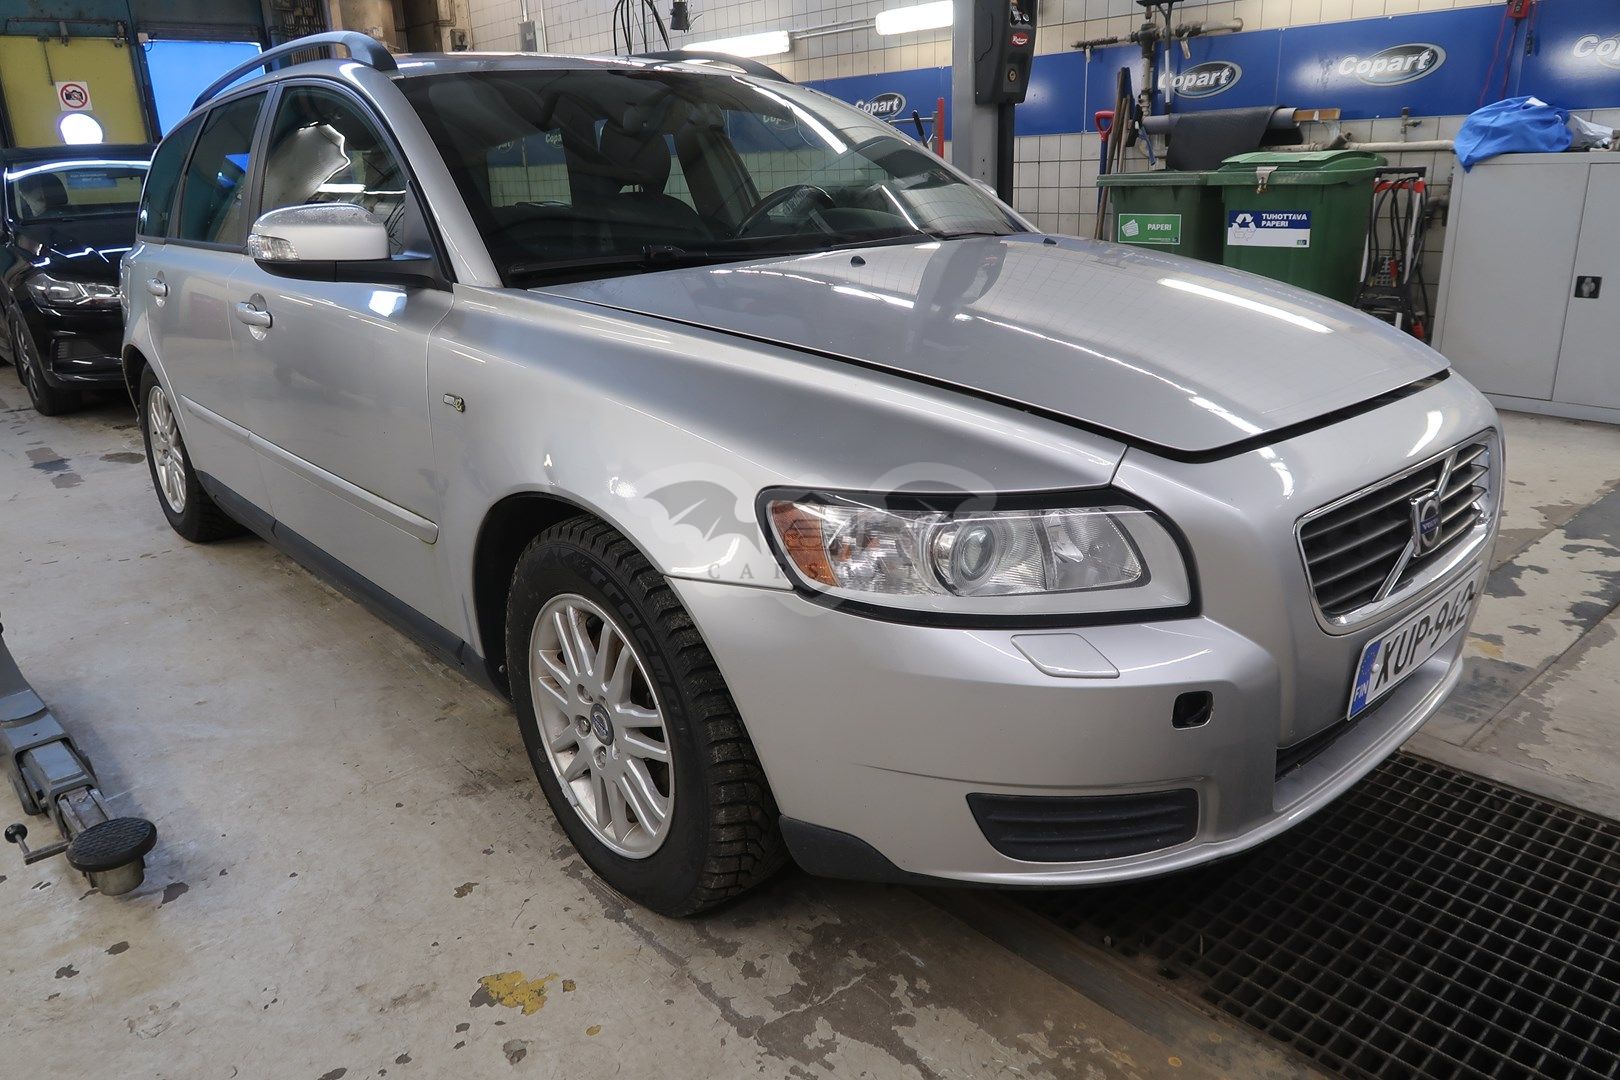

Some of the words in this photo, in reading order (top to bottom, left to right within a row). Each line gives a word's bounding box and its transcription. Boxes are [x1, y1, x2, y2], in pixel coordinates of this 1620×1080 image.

[1574, 36, 1620, 58] Co
[1338, 50, 1432, 78] Copart
[1147, 223, 1172, 231] PAPERI
[1353, 682, 1369, 702] FIN
